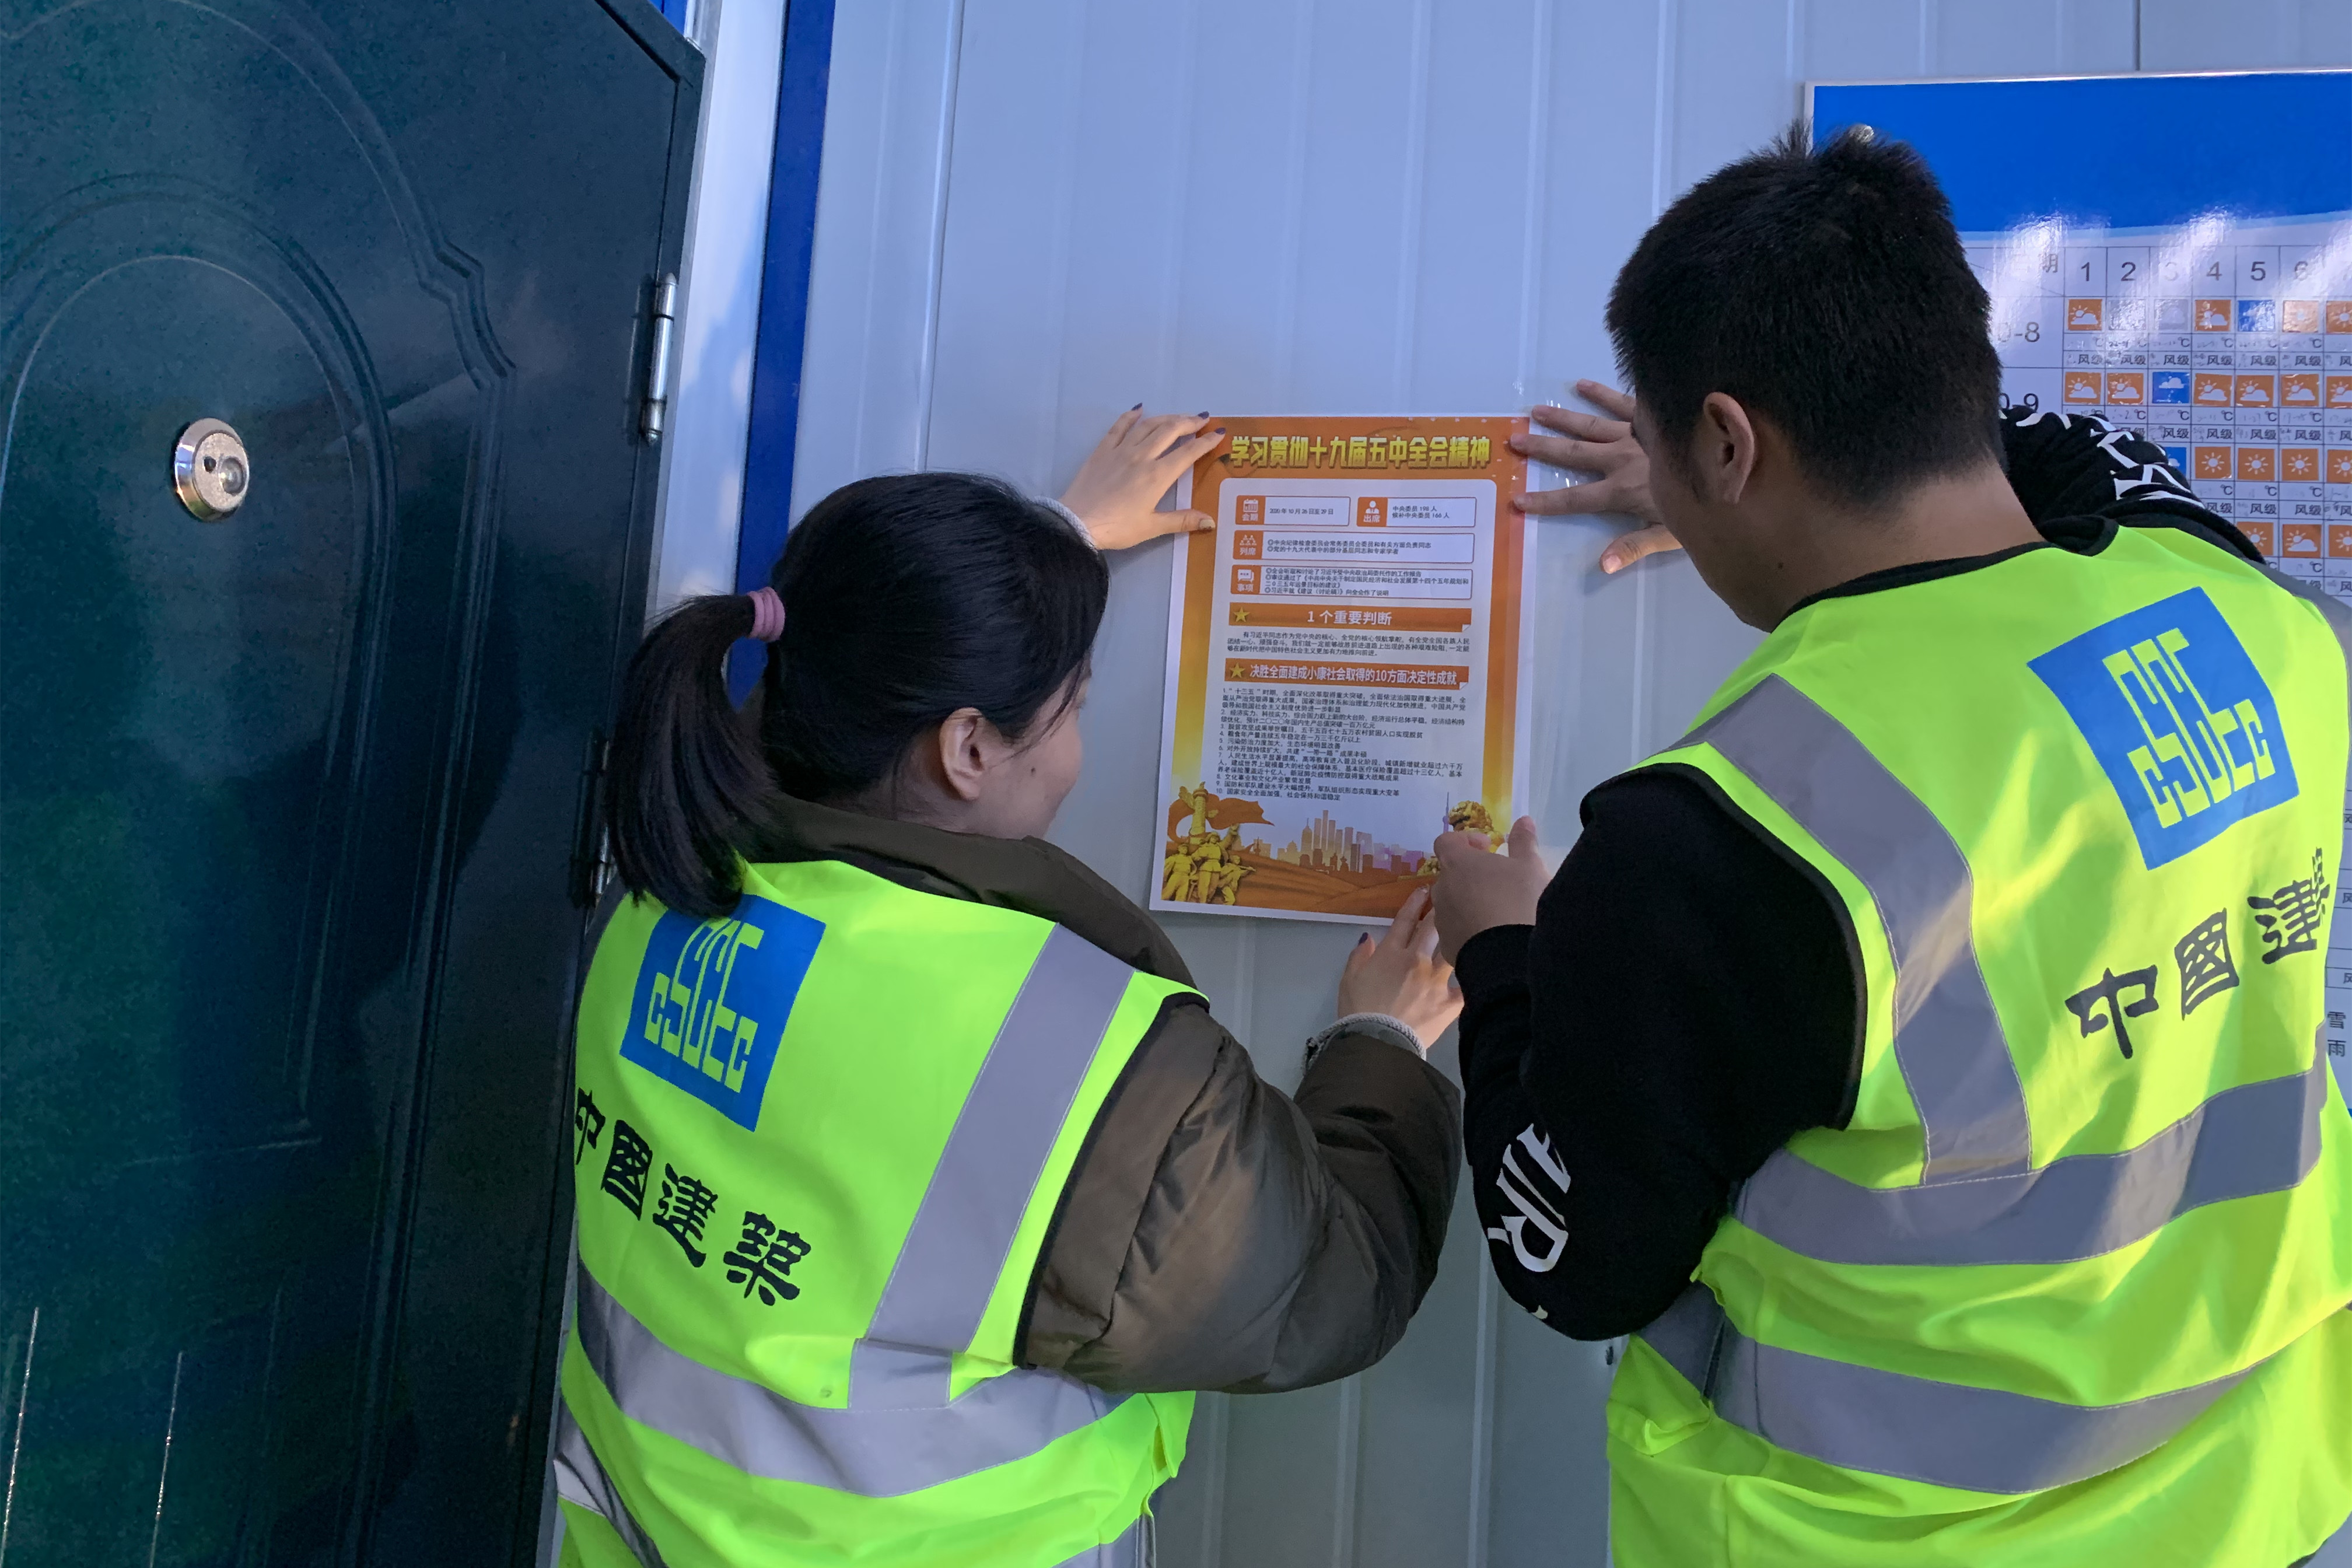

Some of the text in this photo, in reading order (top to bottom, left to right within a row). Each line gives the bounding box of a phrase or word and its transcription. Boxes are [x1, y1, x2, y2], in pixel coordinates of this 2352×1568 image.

[2081, 262, 2090, 281] 1
[2121, 262, 2136, 282] 2
[2207, 261, 2222, 281] 4
[2250, 261, 2266, 281] 5
[2294, 260, 2308, 281] 6
[2164, 354, 2189, 365] 风级
[2207, 355, 2232, 366] 风级
[2250, 355, 2277, 366] 风级
[2295, 355, 2321, 366] 风级
[2164, 428, 2189, 439] 风级
[2207, 428, 2232, 439] 风级
[2250, 429, 2277, 440] 风级
[2295, 429, 2321, 440] 风级
[1230, 435, 1491, 469] 学习贯彻十九届五中全会精神
[2250, 503, 2277, 515] 风级
[2295, 504, 2321, 516] 风级
[1363, 514, 1381, 523] 出席
[1240, 547, 1256, 556] 列席
[2327, 1011, 2346, 1030] 雪
[2327, 1039, 2347, 1058] 雨
